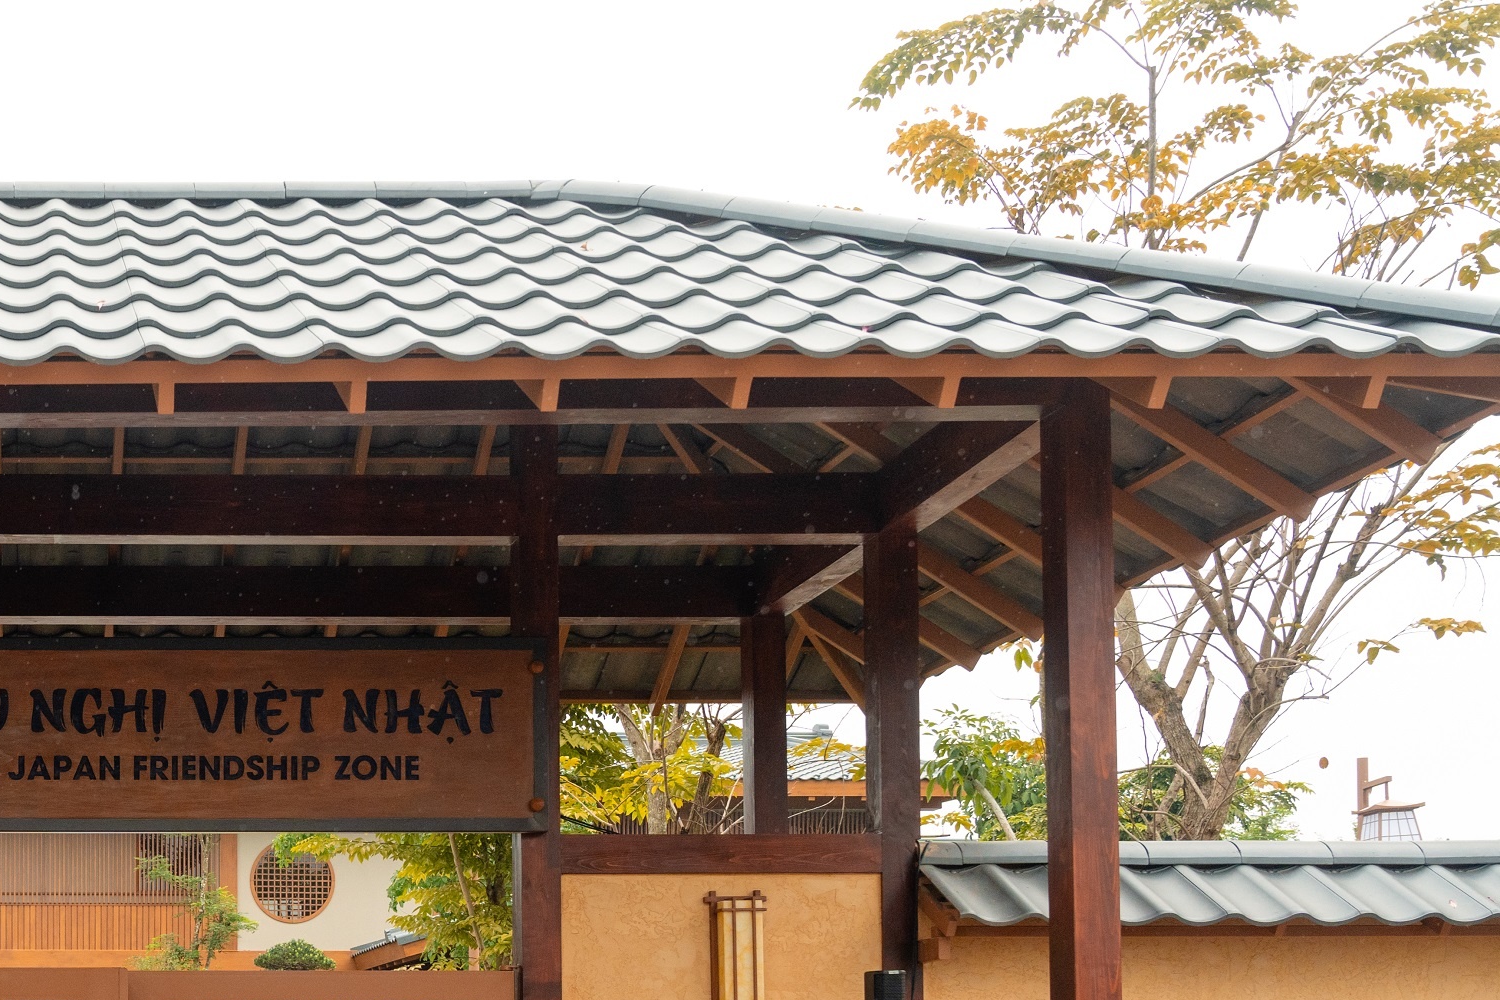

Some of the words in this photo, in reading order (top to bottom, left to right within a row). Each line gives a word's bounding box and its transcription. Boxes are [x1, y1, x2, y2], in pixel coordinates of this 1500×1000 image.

[30, 687, 167, 743] NGHỊ
[190, 680, 324, 743] VIỆT
[342, 680, 503, 744] NHẬT
[8, 756, 121, 780] JAPAN
[133, 756, 320, 781] FRIENDSHIP
[334, 756, 420, 780] ZONE
